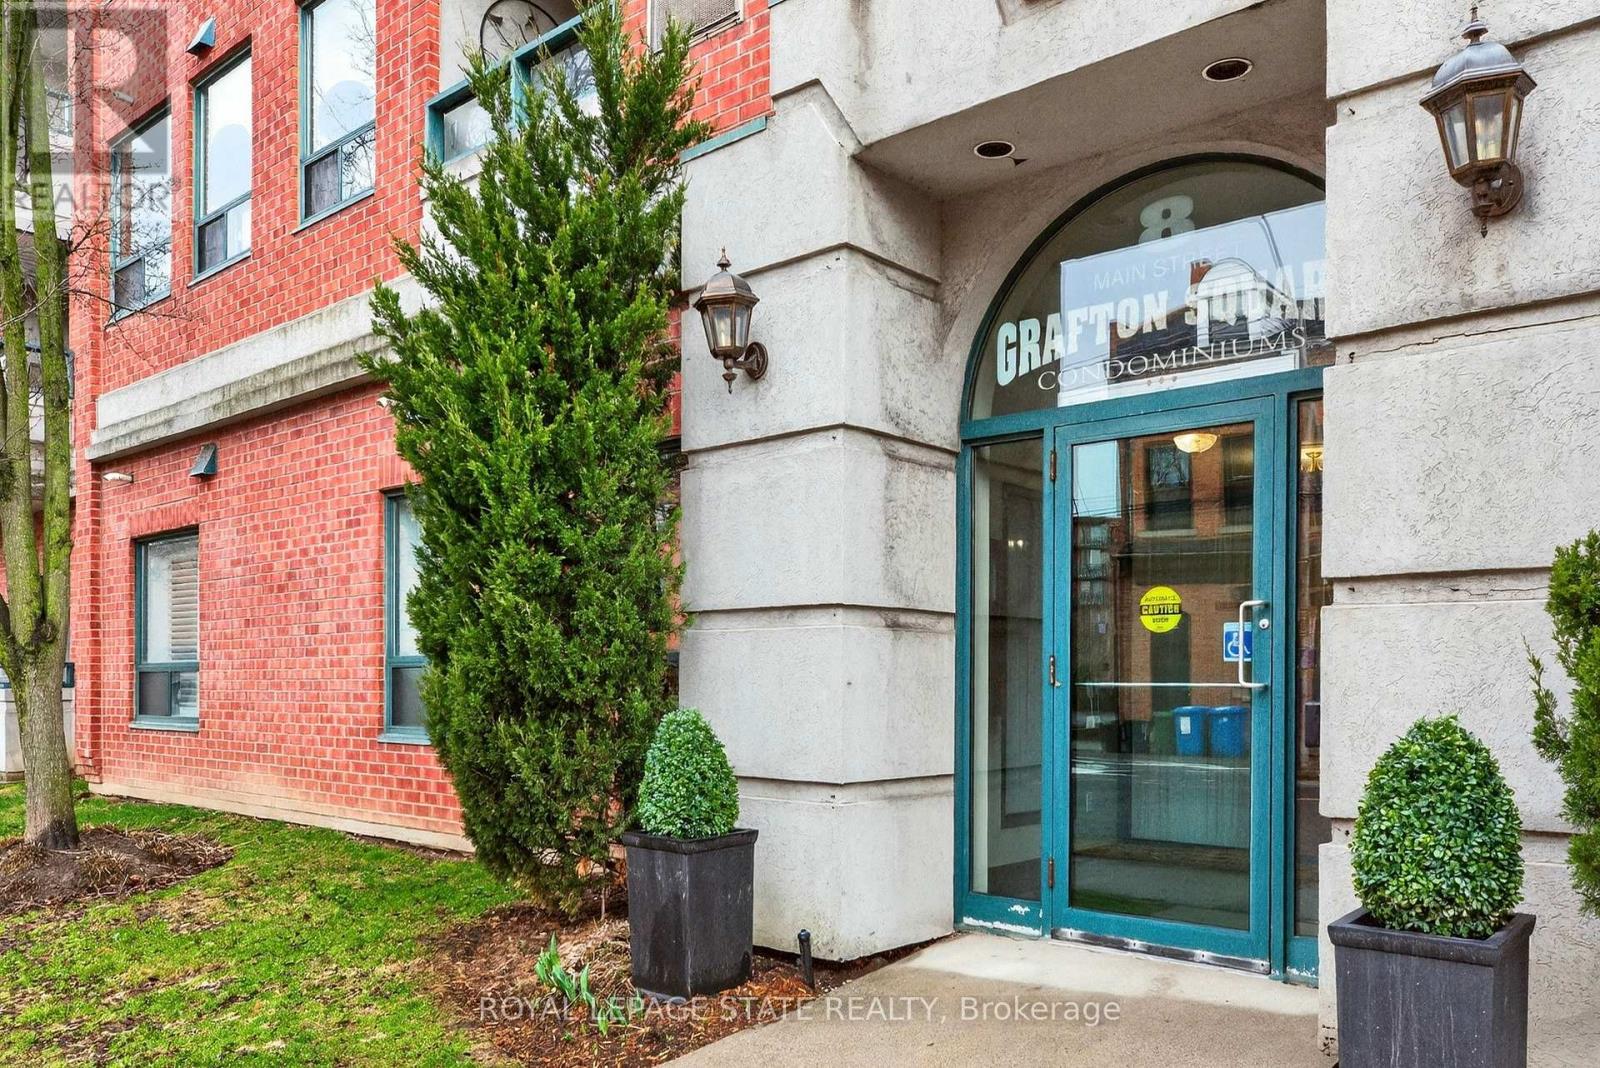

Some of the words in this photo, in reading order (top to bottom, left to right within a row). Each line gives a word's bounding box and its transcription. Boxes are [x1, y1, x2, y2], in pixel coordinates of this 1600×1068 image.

[1138, 194, 1195, 254] 8
[1093, 262, 1147, 291] MAIN
[1152, 241, 1242, 278] STREET
[996, 290, 1170, 387] GRAFTON
[1038, 327, 1307, 390] CONDOMINIUMS
[1141, 604, 1180, 615] CAUTION
